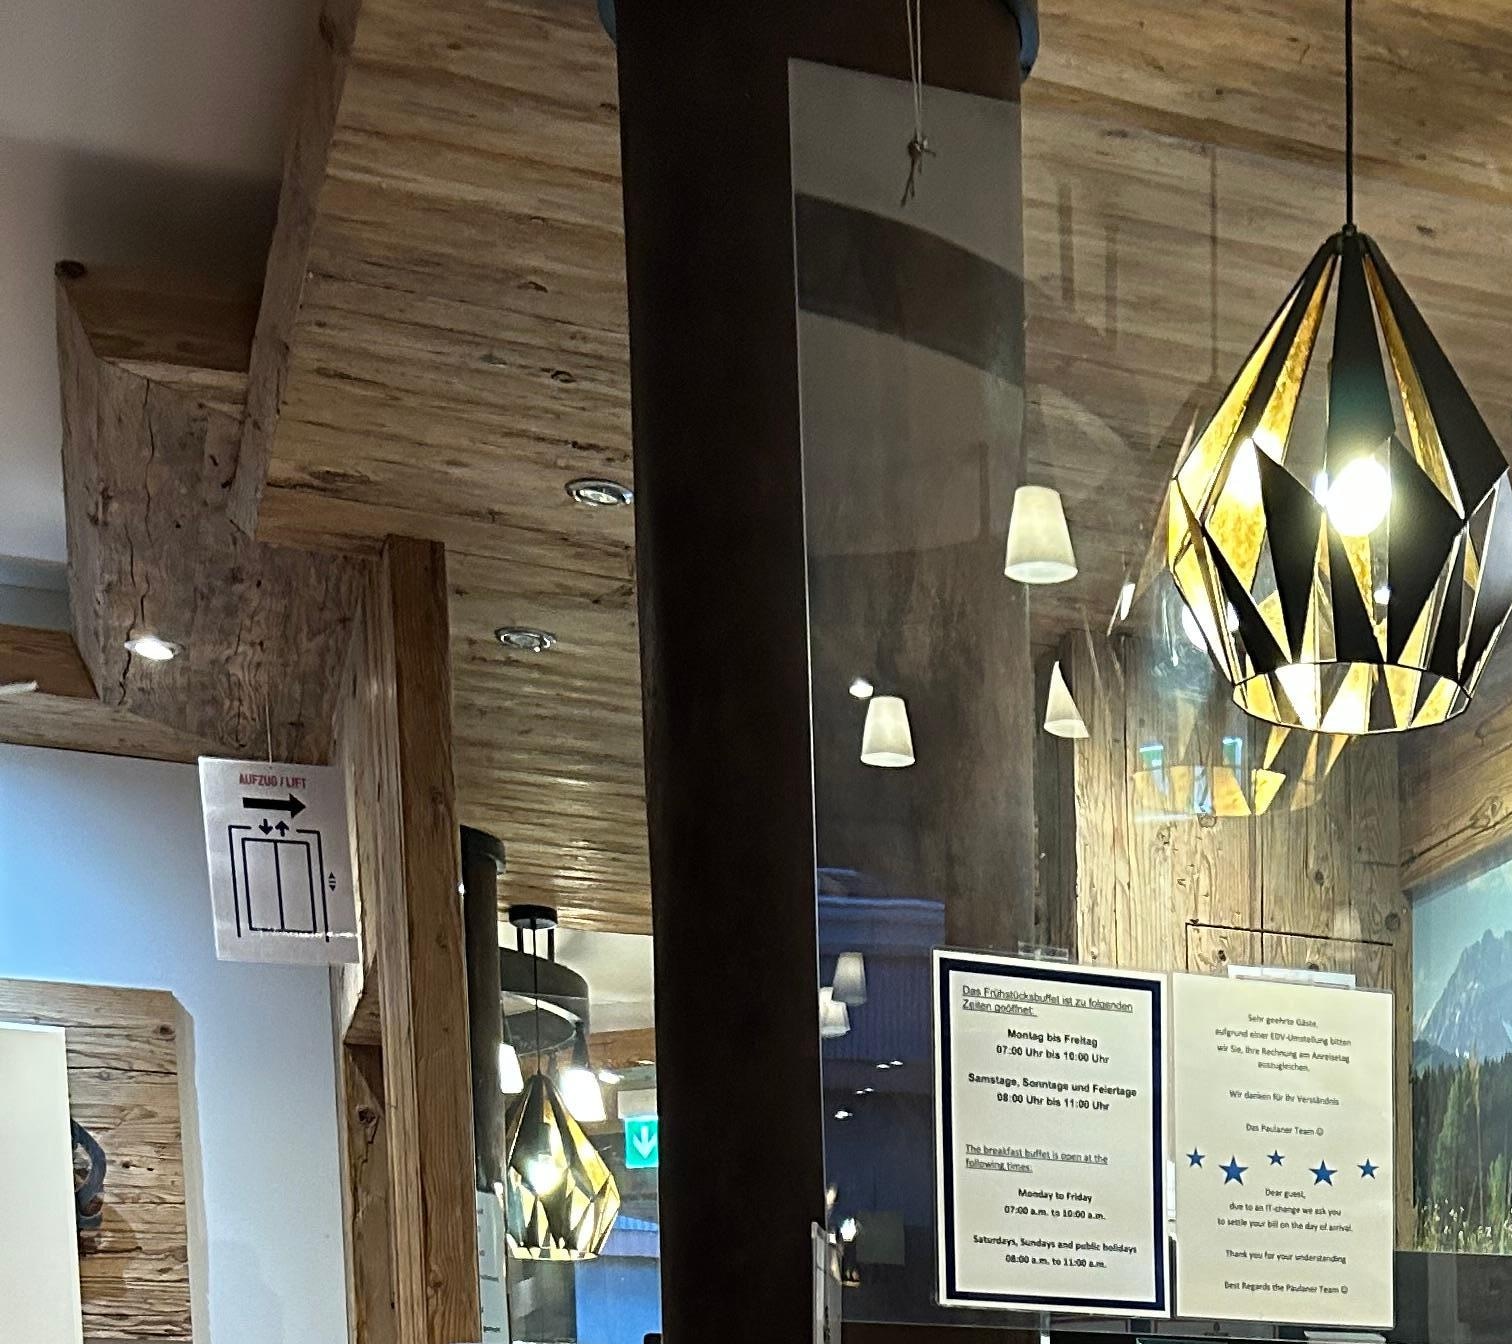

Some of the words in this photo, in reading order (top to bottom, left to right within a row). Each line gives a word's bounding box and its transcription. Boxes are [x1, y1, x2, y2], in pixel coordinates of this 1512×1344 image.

[280, 777, 283, 786] /
[286, 777, 306, 789] LIFT
[962, 985, 981, 996] Das
[984, 987, 1059, 1002] Frühstücksbuffet
[1062, 995, 1072, 1003] ist
[1075, 998, 1086, 1006] zu
[1089, 998, 1133, 1011] folgenden
[962, 999, 992, 1010] Zeiten
[1248, 1014, 1264, 1022] Sehr
[1266, 1016, 1294, 1026] geehrte
[1008, 1029, 1044, 1043] Montag
[1047, 1033, 1062, 1043] bis
[1065, 1035, 1098, 1048] Freitag
[1215, 1028, 1248, 1037] aufgrund
[1250, 1031, 1269, 1040] einer
[1330, 1038, 1351, 1046] bitten
[996, 1045, 1023, 1056] 07:00
[1026, 1048, 1043, 1058] Uhr
[1046, 1050, 1060, 1060] bis
[1064, 1052, 1089, 1062] 10:00
[1092, 1054, 1109, 1064] Uhr
[1217, 1044, 1228, 1052] wir
[1245, 1047, 1260, 1055] Ihre
[1262, 1048, 1297, 1059] Rechnung
[968, 1073, 1020, 1088] Samstage,
[1023, 1078, 1068, 1092] Sonntage
[1072, 1083, 1089, 1093] und
[1093, 1085, 1137, 1098] Feiertage
[997, 1093, 1023, 1103] 08:00
[1026, 1095, 1044, 1106] Uhr
[1047, 1097, 1061, 1107] bis
[1065, 1100, 1089, 1109] 11:00
[1093, 1101, 1109, 1111] Uhr
[1229, 1090, 1242, 1098] Wir
[1244, 1091, 1271, 1100] danken
[1273, 1093, 1283, 1101] für
[1297, 1095, 1339, 1105] Verständnis
[1246, 1123, 1259, 1132] Das
[1261, 1124, 1292, 1134] Paulaner
[1295, 1127, 1314, 1135] Team
[966, 1144, 982, 1155] The
[983, 1145, 1023, 1157] breakfast
[1025, 1148, 1050, 1159] buffet
[1052, 1152, 1059, 1160] is
[1061, 1153, 1082, 1163] open
[1084, 1154, 1092, 1162] at
[1094, 1155, 1108, 1163] the
[966, 1158, 1005, 1170] following
[1018, 1188, 1053, 1200] Monday
[1056, 1192, 1064, 1200] to
[1067, 1192, 1092, 1203] Friday
[1265, 1188, 1283, 1197] Dear
[1284, 1191, 1306, 1199] guest,
[1004, 1206, 1028, 1214] 07:00
[1030, 1208, 1049, 1216] a.m.
[1051, 1209, 1060, 1217] to
[1062, 1210, 1086, 1218] 10:00
[1088, 1212, 1106, 1220] a.m.
[1229, 1202, 1243, 1210] due
[1305, 1223, 1317, 1231] day
[973, 1235, 1018, 1247] Saturdays,
[1020, 1238, 1055, 1249] Sundays
[1058, 1241, 1073, 1249] and
[1076, 1242, 1100, 1251] public
[1102, 1244, 1137, 1254] holidays
[1006, 1255, 1029, 1263] 08:00
[1032, 1256, 1050, 1265] a.m.
[1063, 1258, 1087, 1267] 11:00
[1226, 1250, 1247, 1258] Thank
[1249, 1252, 1263, 1260] you
[1265, 1251, 1274, 1259] for
[1295, 1254, 1346, 1264] understanding
[1225, 1281, 1240, 1289] Best
[1242, 1282, 1270, 1292] Regards
[1286, 1284, 1317, 1293] Paulaner
